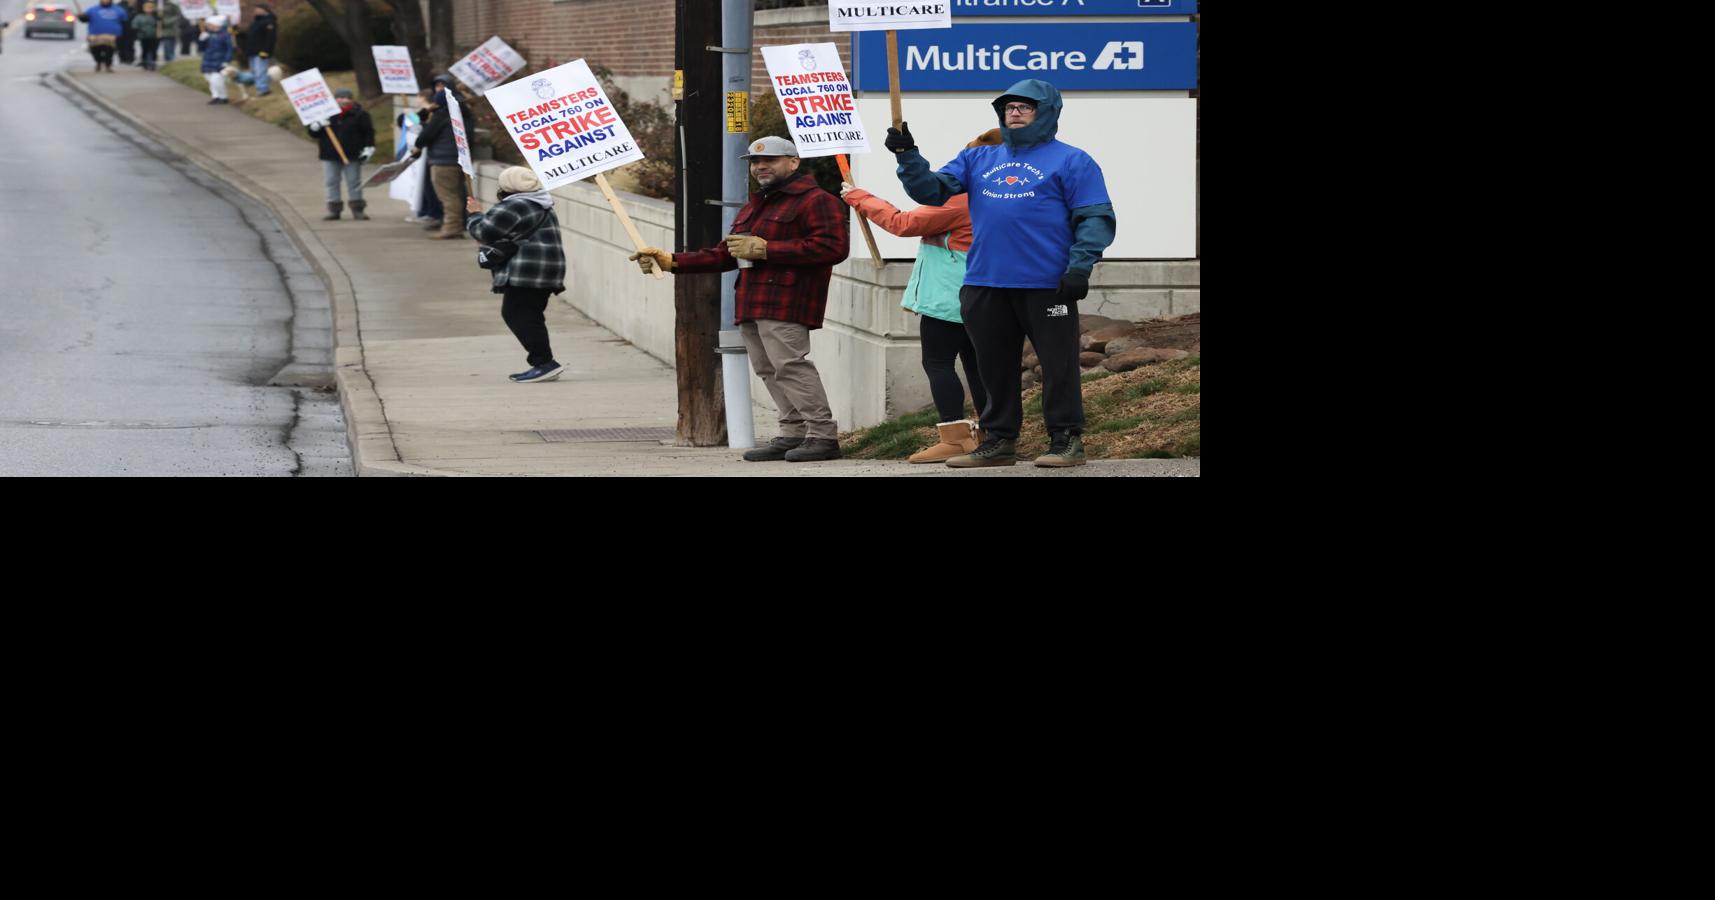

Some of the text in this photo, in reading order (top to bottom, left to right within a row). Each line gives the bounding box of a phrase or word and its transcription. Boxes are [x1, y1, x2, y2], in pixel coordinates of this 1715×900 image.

[837, 3, 945, 18] MULTICARE
[905, 44, 1087, 71] MultiCare
[775, 71, 845, 86] TEAMSTERS
[780, 83, 849, 96] LOCAL 760 ON
[506, 87, 599, 124] TEAMSTERS
[783, 93, 854, 115] STRIKE
[513, 97, 605, 134] LOCAL 760 ON
[795, 112, 852, 128] AGAINST
[519, 106, 617, 150] STRIKE
[798, 131, 864, 144] MULTICARE
[538, 124, 616, 162] AGAINST
[543, 141, 634, 181] MULTICARE
[982, 161, 1044, 180] MultiCare Tech's
[982, 188, 1035, 199] Union Strong
